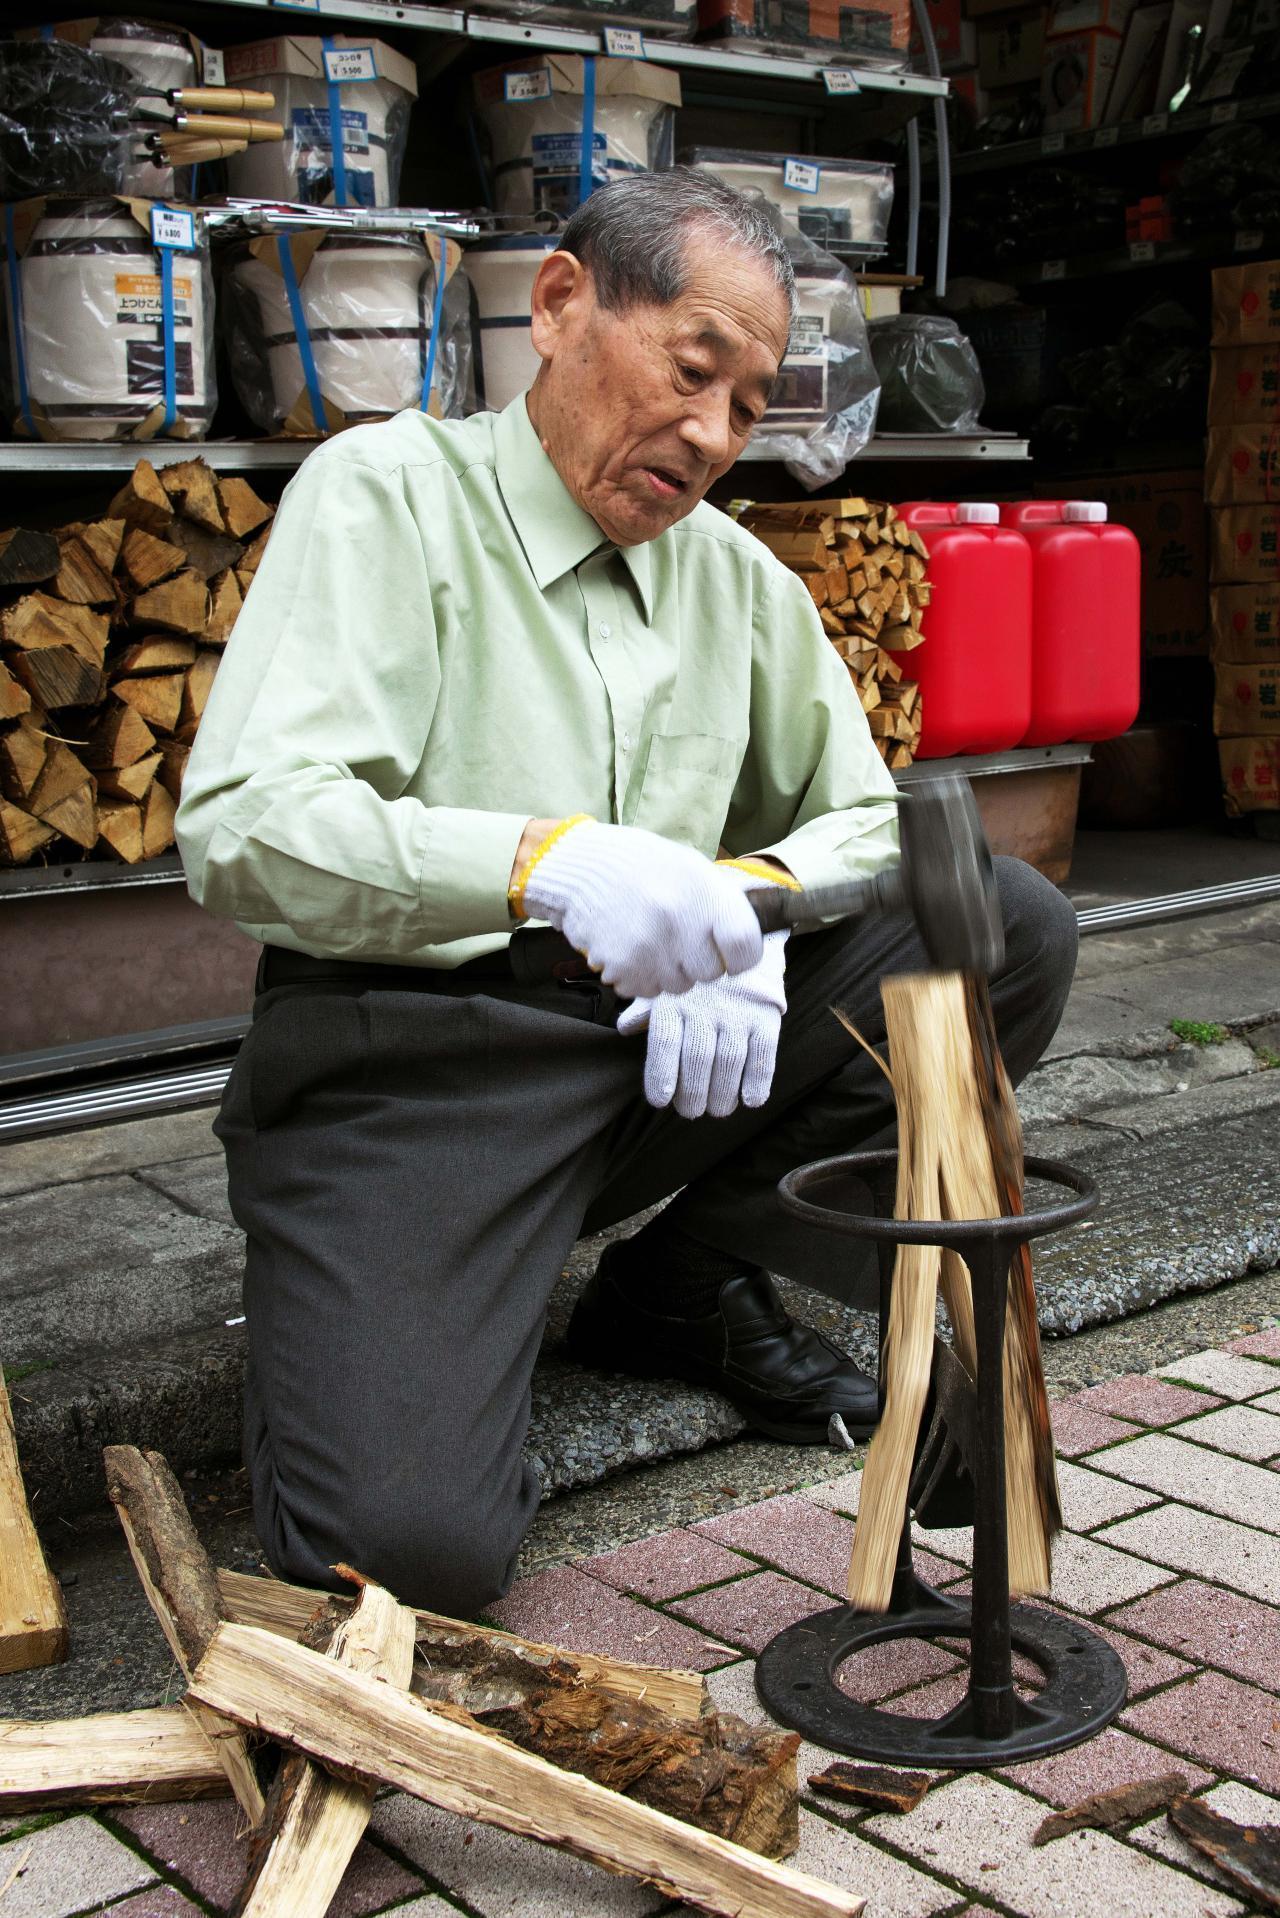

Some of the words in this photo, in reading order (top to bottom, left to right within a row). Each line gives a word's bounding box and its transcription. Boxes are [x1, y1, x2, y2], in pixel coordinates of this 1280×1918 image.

[119, 297, 164, 309] 上つけこん
